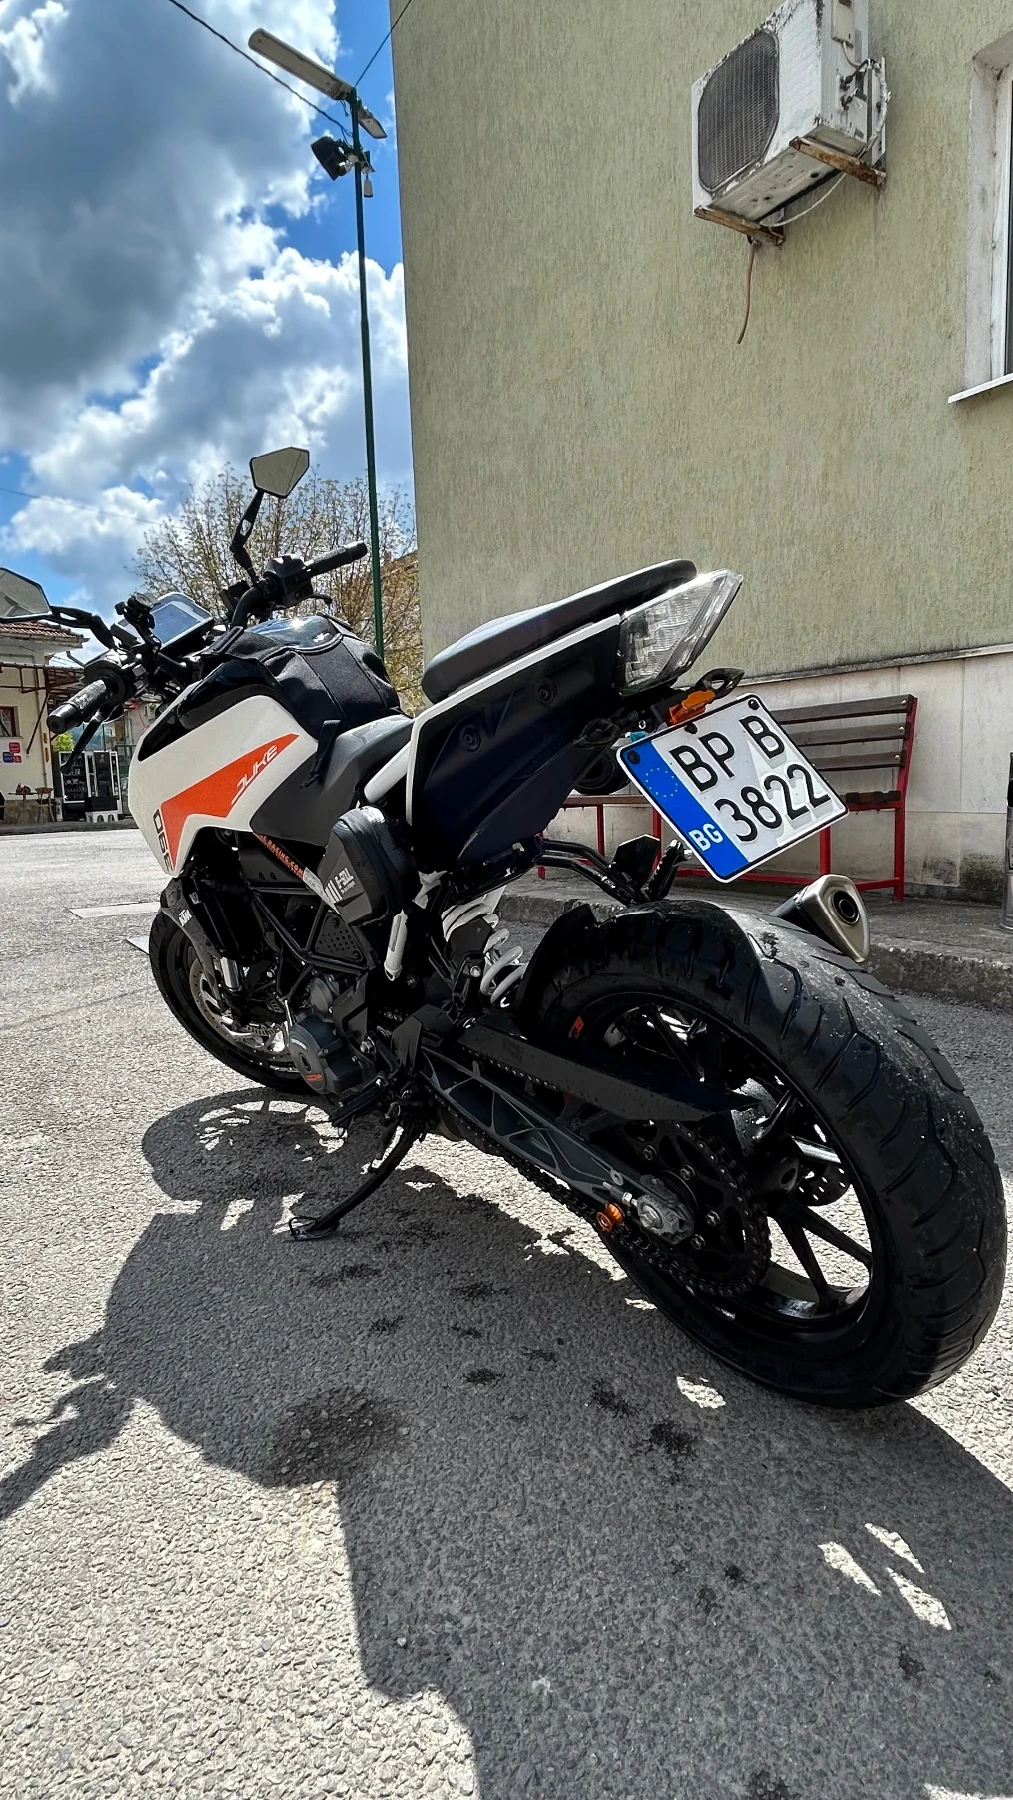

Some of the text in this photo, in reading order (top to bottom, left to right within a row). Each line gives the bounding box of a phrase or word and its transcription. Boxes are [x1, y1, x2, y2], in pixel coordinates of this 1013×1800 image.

[231, 744, 278, 806] DUKE
[669, 716, 785, 792] BP B
[714, 763, 831, 842] 3822
[689, 823, 724, 852] BG
